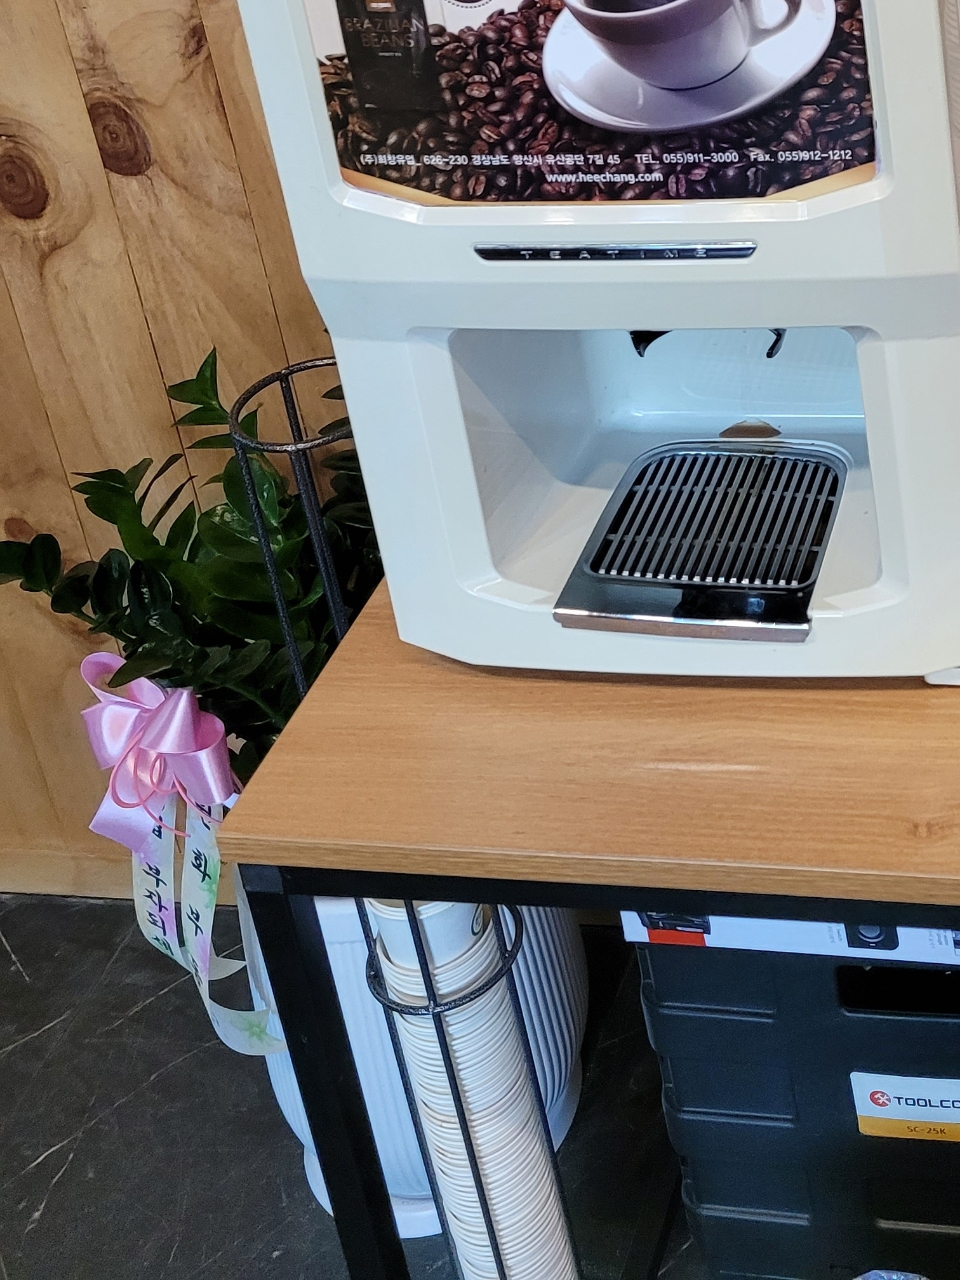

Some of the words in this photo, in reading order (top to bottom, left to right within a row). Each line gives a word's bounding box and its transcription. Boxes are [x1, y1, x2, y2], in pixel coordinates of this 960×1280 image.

[423, 154, 469, 166] 626-230
[471, 154, 511, 166] 경상남도
[513, 154, 543, 166] 양산시
[606, 154, 621, 165] 45
[634, 153, 660, 164] TEL.
[662, 152, 739, 165] 055)911-3000
[750, 151, 775, 163] Fax.
[777, 150, 853, 163] 055)912-1212
[546, 171, 664, 184] www.heechang.com
[906, 1125, 947, 1135] SC-25K
